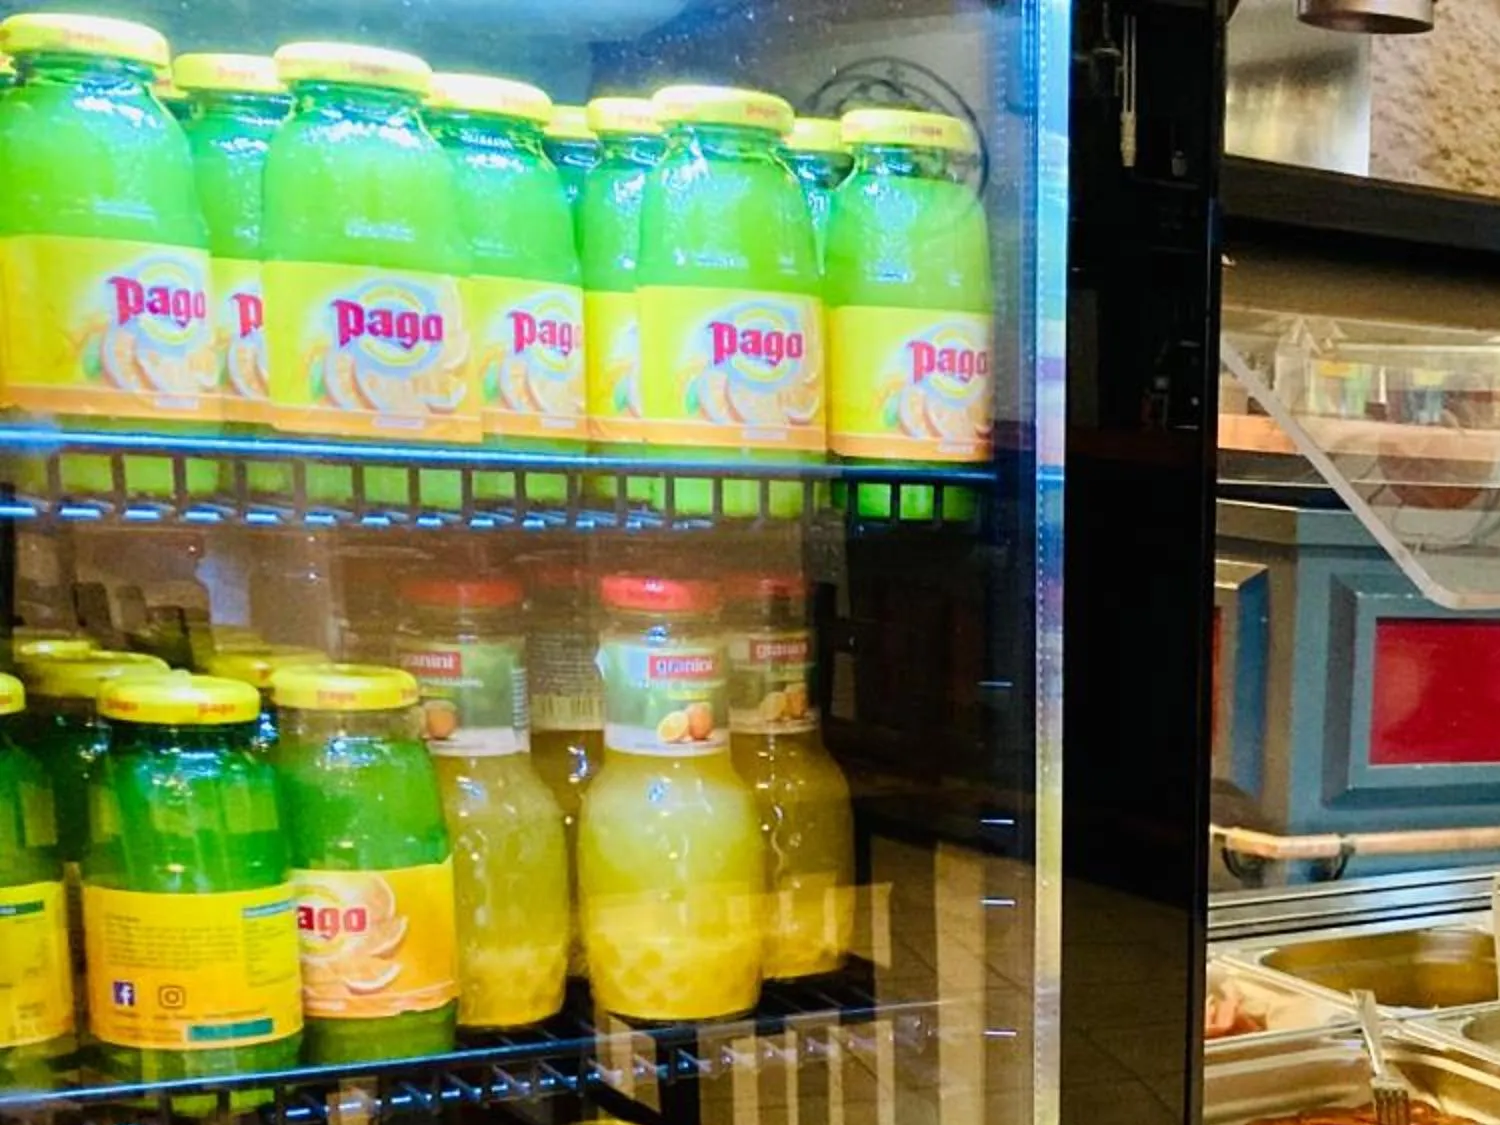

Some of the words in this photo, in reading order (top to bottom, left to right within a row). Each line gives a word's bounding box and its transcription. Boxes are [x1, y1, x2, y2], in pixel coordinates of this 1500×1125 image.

[106, 276, 206, 328] pago
[331, 298, 443, 350] pago
[708, 321, 803, 366] pago
[907, 341, 988, 384] pago
[297, 906, 367, 939] ago
